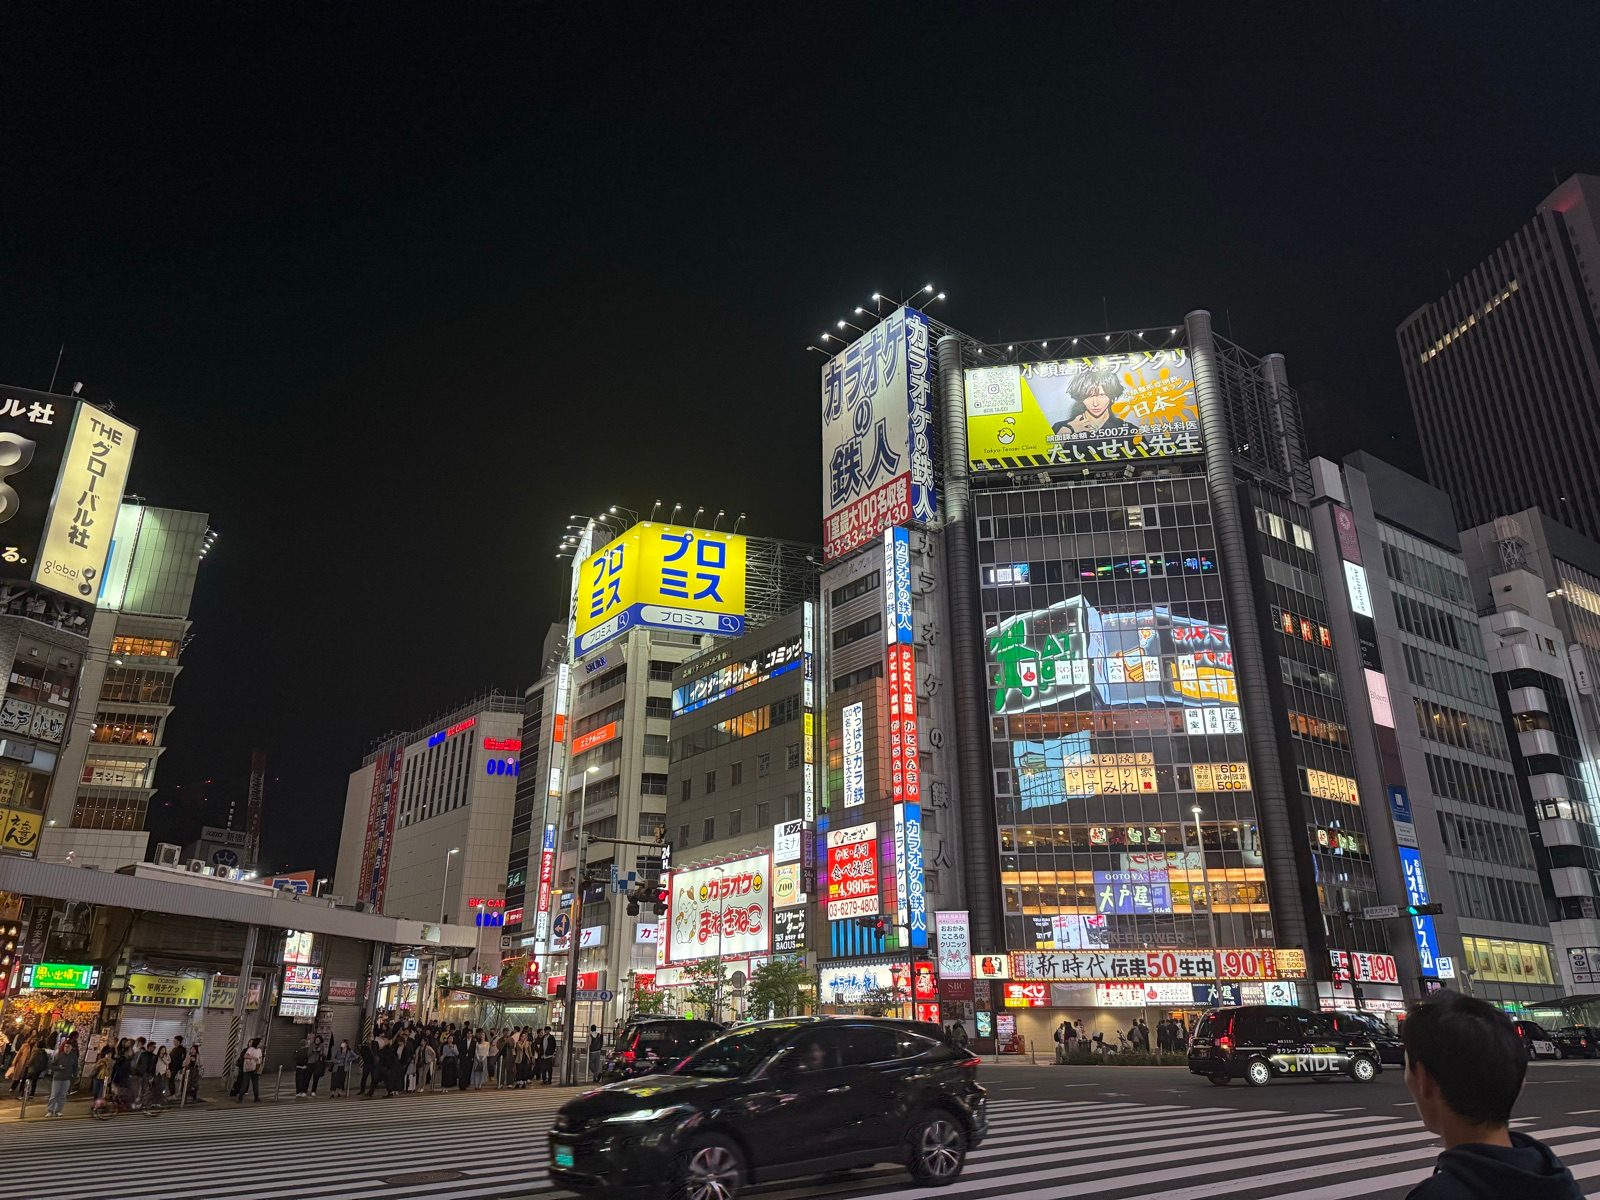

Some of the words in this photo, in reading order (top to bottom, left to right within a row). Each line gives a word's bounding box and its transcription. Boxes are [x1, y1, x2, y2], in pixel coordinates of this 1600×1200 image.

[823, 317, 904, 427] カラオケ
[853, 395, 873, 440] の
[907, 314, 935, 522] カラオケの鉄人
[1132, 391, 1194, 418] 日本一
[90, 417, 123, 446] THE
[984, 447, 1000, 455] Tokyo
[1047, 433, 1204, 464] たいせい先生
[830, 417, 901, 510] 鉄人
[68, 440, 112, 549] グローバル社
[592, 542, 624, 587] プロ
[660, 533, 726, 569] プロ
[44, 559, 80, 579] global
[589, 576, 622, 619] ミス
[659, 567, 724, 603] ミス
[885, 541, 896, 629] カラオケの鉄人
[895, 540, 912, 631] カラオケの鉄人
[660, 611, 706, 626] プロミス
[589, 624, 612, 643] プロミス
[902, 651, 914, 715] かに食べ放題
[1220, 764, 1246, 773] 60分
[1069, 784, 1081, 793] 5F
[1083, 780, 1138, 794] すみれ
[1217, 780, 1248, 790] 500円
[1319, 786, 1350, 802] すみれ
[785, 822, 802, 835] メンズ
[543, 853, 552, 880] カラオケ
[831, 858, 874, 881] 食べ放題
[895, 821, 908, 928] カラオケの鉄人
[906, 819, 926, 930] カラオケの鉄人
[706, 872, 754, 900] カラオケ
[1099, 884, 1153, 913] 大戸屋
[775, 910, 805, 925] ビリヤード
[828, 897, 878, 918] 03-6279-4800
[698, 903, 763, 945] まねきねこ
[786, 922, 805, 934] ダーツ
[1036, 953, 1109, 978] 新時代
[1111, 957, 1147, 978] 伝串
[1147, 952, 1177, 978] 50
[1179, 957, 1213, 977] 生中
[1264, 952, 1271, 967] 2F
[1367, 954, 1397, 982] 190
[36, 966, 83, 982] 思い出横丁
[1280, 971, 1300, 979] すみれ
[1009, 985, 1045, 998] 宝くじ
[1208, 984, 1235, 1002] 大屋
